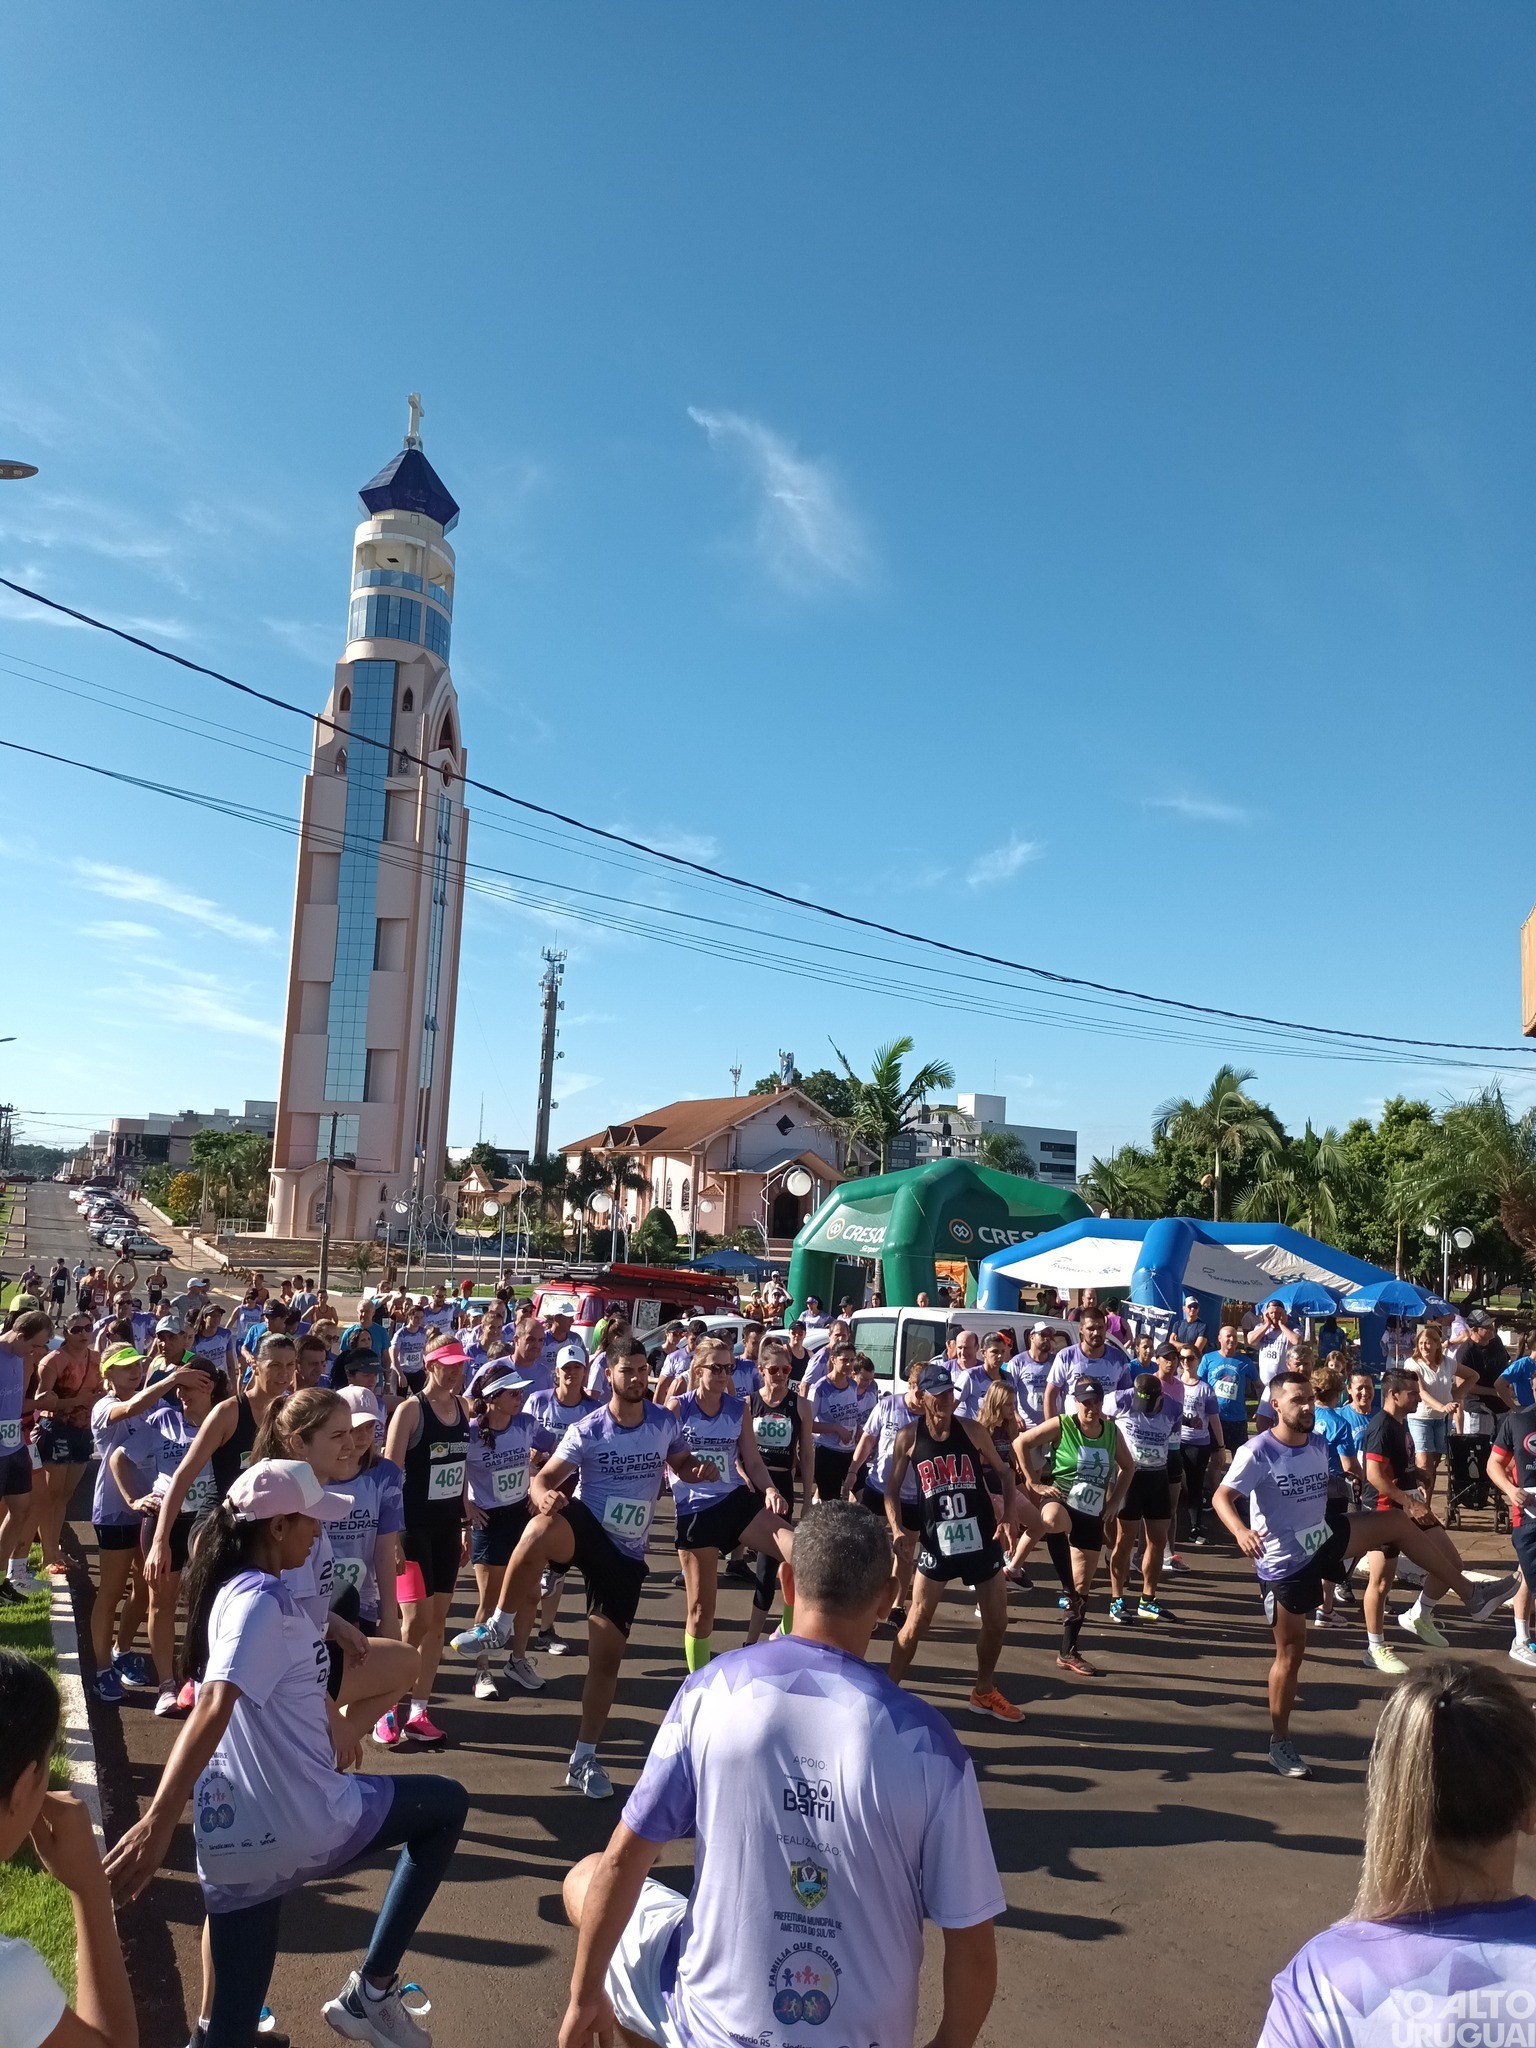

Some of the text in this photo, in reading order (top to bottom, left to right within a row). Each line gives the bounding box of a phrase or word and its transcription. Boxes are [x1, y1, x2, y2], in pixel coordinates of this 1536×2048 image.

[842, 1224, 887, 1243] CRESOL
[978, 1226, 1047, 1245] CRES
[1218, 1383, 1235, 1395] 435
[758, 1422, 787, 1438] 568
[485, 1458, 502, 1468] DAS
[598, 1450, 661, 1465] 2ª RÚSTICA
[435, 1466, 463, 1488] 462
[601, 1465, 624, 1474] DAS
[498, 1469, 525, 1492] 597
[1276, 1473, 1296, 1487] 2ª
[1282, 1486, 1304, 1497] DAS
[611, 1502, 646, 1527] 476
[939, 1493, 967, 1520] 30
[330, 1520, 379, 1530] PEDRAS
[944, 1523, 974, 1544] 441
[1304, 1527, 1328, 1552] 421
[319, 1583, 334, 1596] DA
[793, 1755, 828, 1771] APOIO:
[797, 1781, 818, 1801] Do
[783, 1789, 835, 1823] Barril
[776, 1833, 842, 1857] REALIZAÇÃO:
[773, 1910, 843, 1930] PREFEITURA MUNICIPAL DE
[780, 1922, 836, 1939] AMETISTA DO SUL/RS
[792, 1941, 813, 1951] QUE
[815, 1945, 843, 1976] CORRE
[727, 2031, 771, 2048] omércio RS
